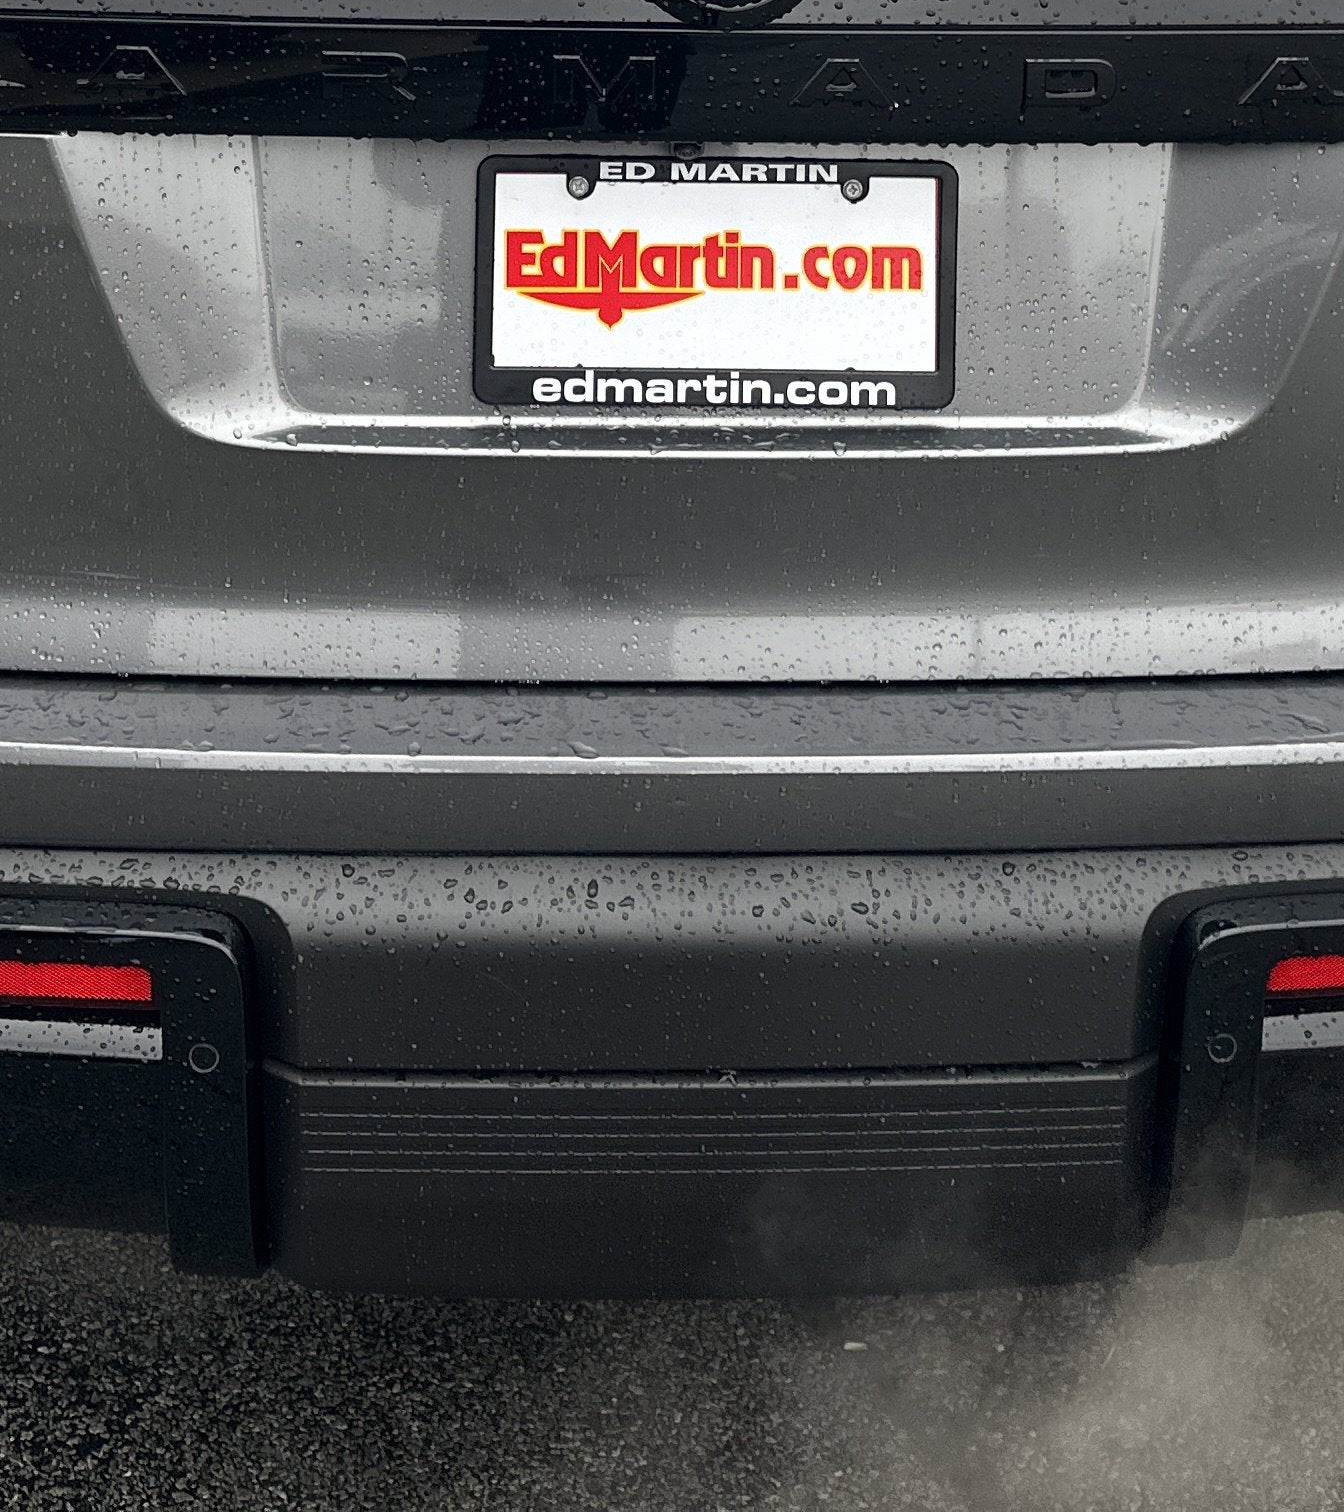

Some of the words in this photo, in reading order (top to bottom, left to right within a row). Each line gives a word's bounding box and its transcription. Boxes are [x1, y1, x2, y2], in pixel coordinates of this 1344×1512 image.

[599, 161, 660, 181] ED
[670, 162, 839, 183] MARTIN
[503, 228, 924, 292] EdMartin.com
[532, 371, 897, 406] edmartin.com
